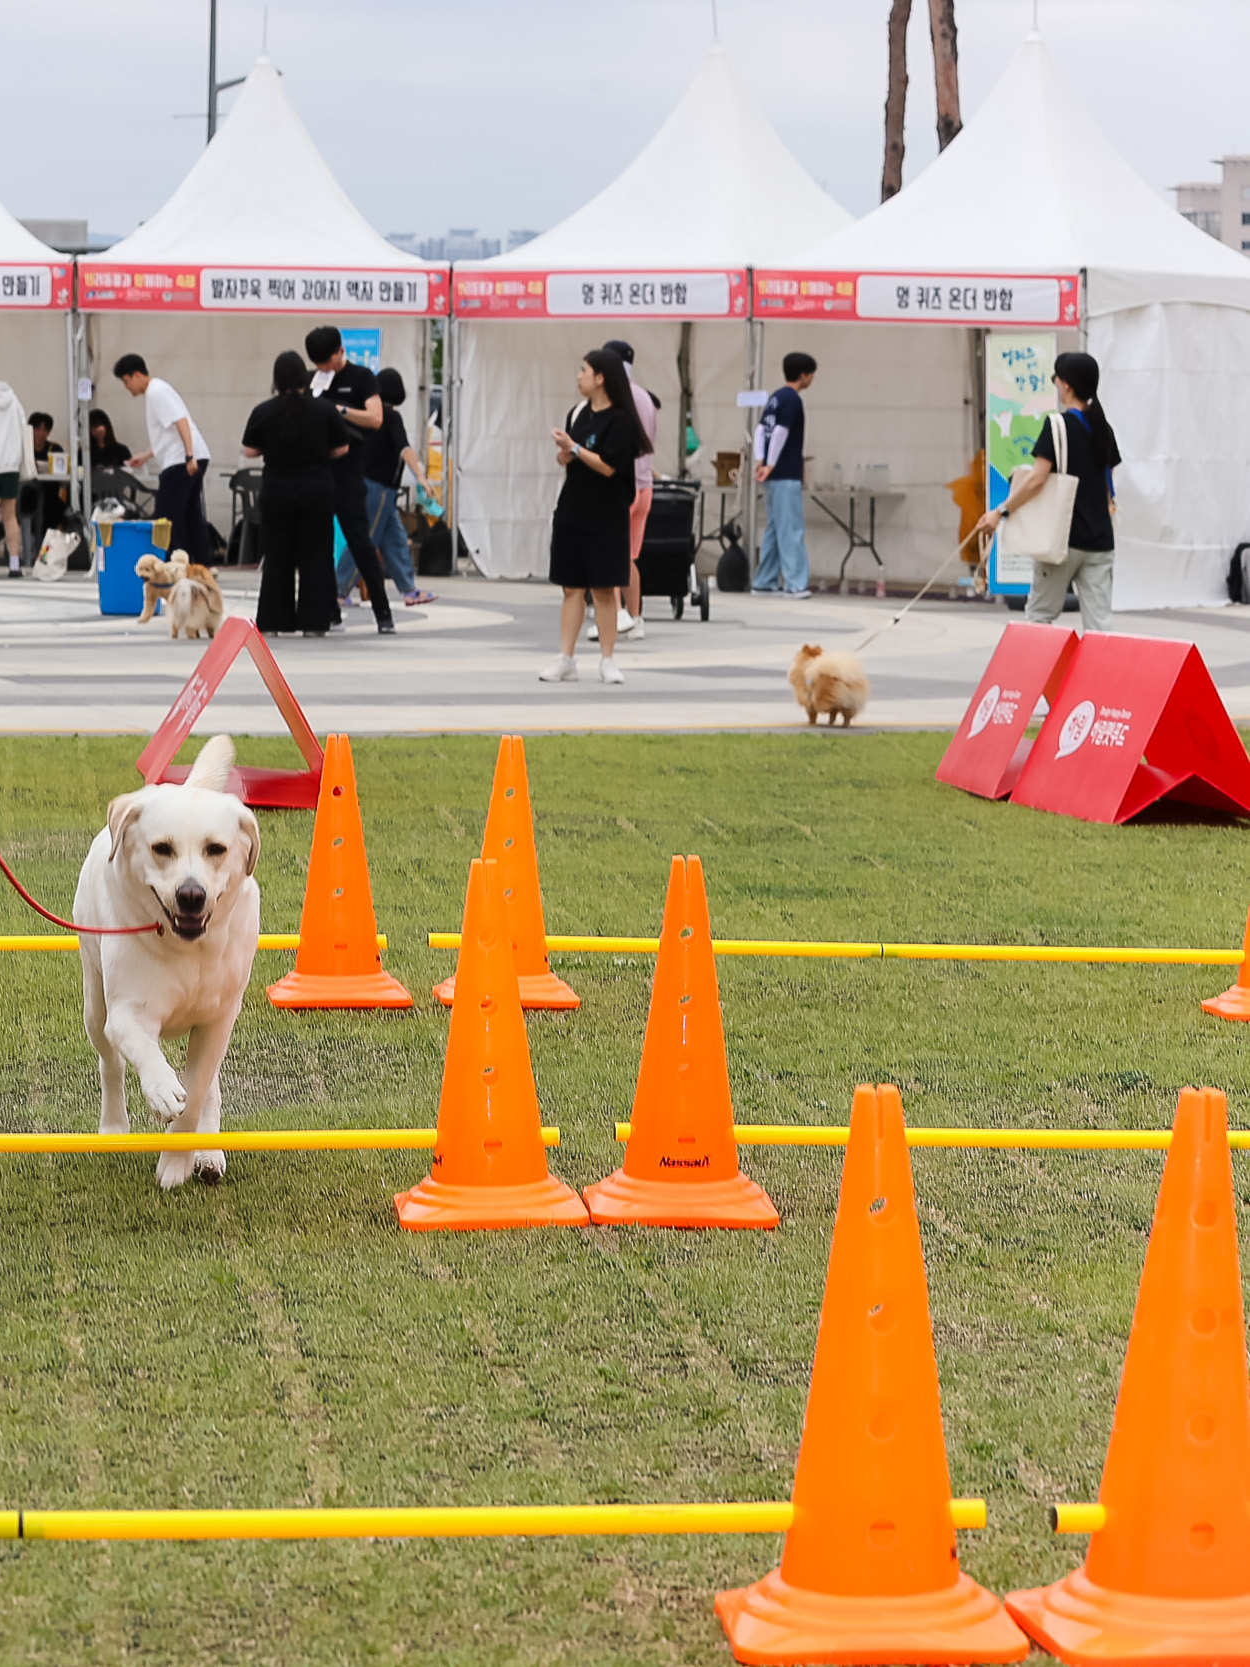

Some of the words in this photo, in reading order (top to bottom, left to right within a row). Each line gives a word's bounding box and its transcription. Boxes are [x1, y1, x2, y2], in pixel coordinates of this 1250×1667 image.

[2, 275, 41, 297] 만들기
[211, 278, 261, 300] 발자꾸욱
[268, 279, 296, 300] 찍어
[301, 279, 341, 301] 강아지
[346, 280, 374, 302] 액자
[379, 281, 418, 303] 만들기
[581, 283, 594, 305] 멍
[600, 283, 624, 305] 퀴즈
[629, 283, 655, 305] 온더
[896, 286, 910, 309] 멍
[917, 286, 942, 310] 퀴즈
[949, 287, 977, 311] 온더
